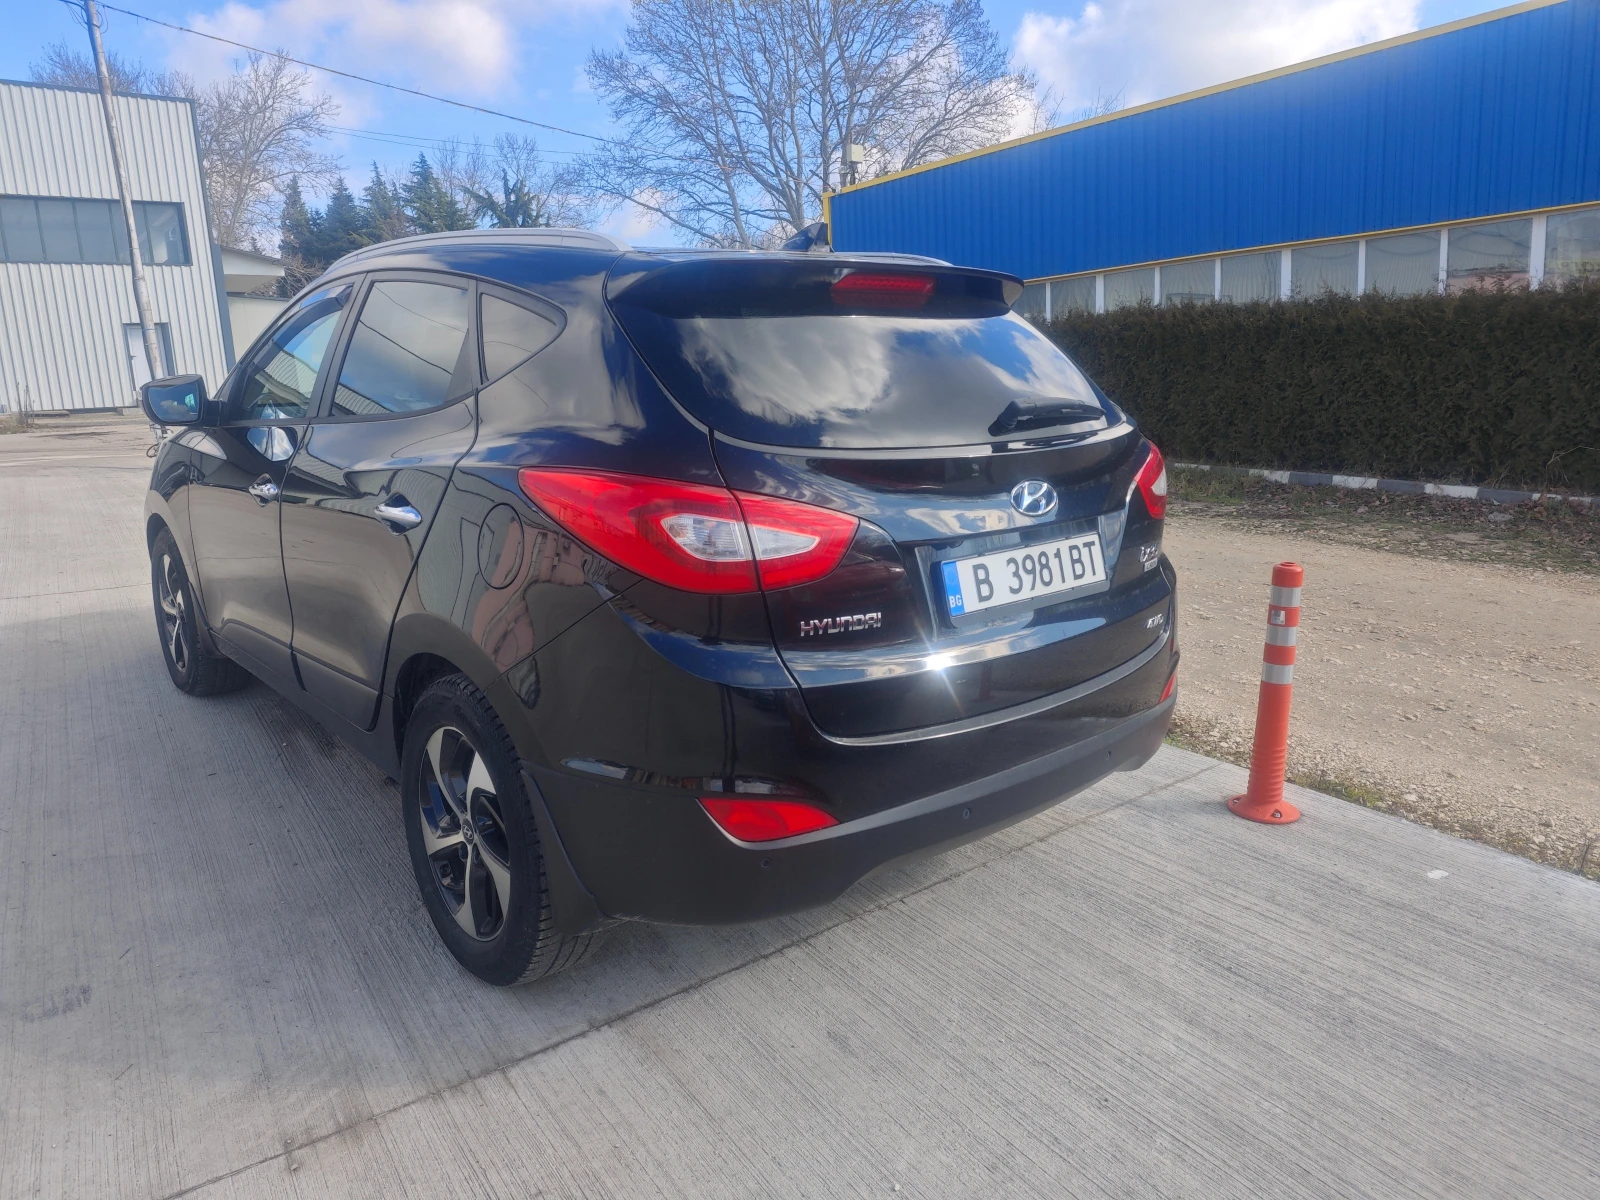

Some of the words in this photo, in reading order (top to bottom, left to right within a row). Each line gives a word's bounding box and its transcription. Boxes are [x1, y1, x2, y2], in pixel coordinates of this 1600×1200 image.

[972, 563, 994, 603] B
[1006, 541, 1096, 595] 3981BT
[949, 594, 962, 608] BG
[800, 612, 882, 637] HYUNDAI
